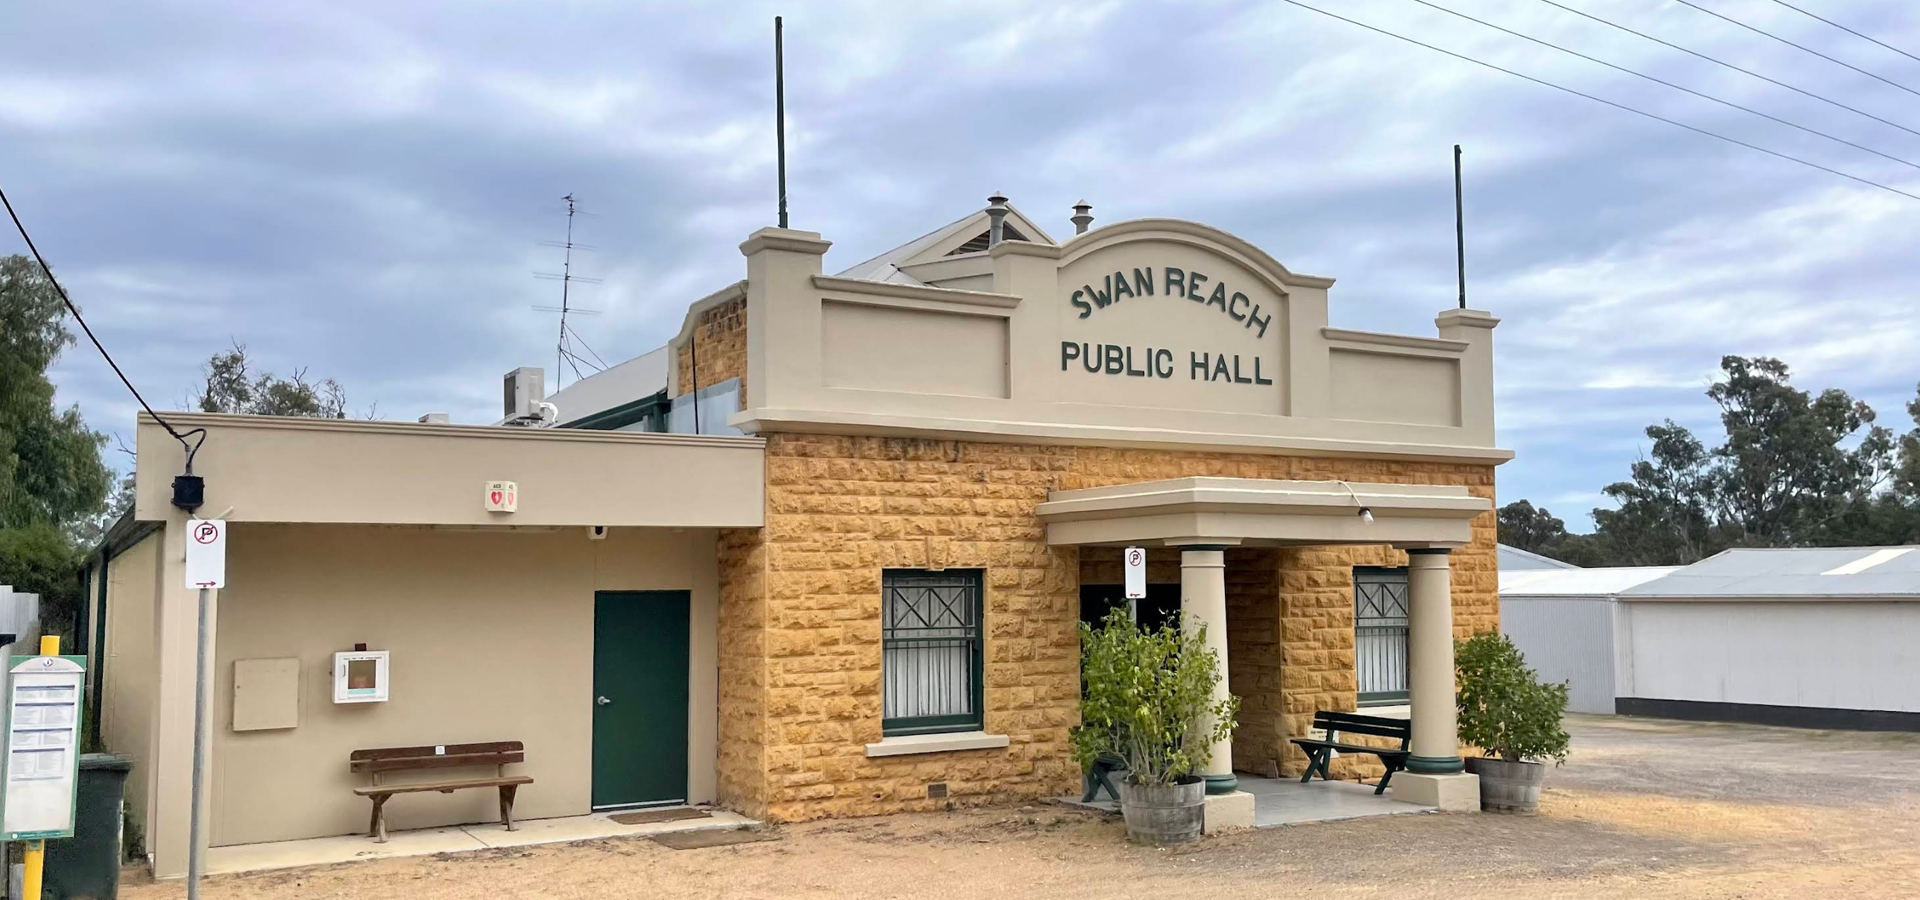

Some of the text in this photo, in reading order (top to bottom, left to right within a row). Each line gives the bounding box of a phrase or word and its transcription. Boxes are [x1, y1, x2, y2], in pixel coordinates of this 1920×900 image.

[1071, 266, 1272, 339] SWAN REACH
[1061, 341, 1273, 386] PUBLIC HALL
[202, 528, 213, 540] P
